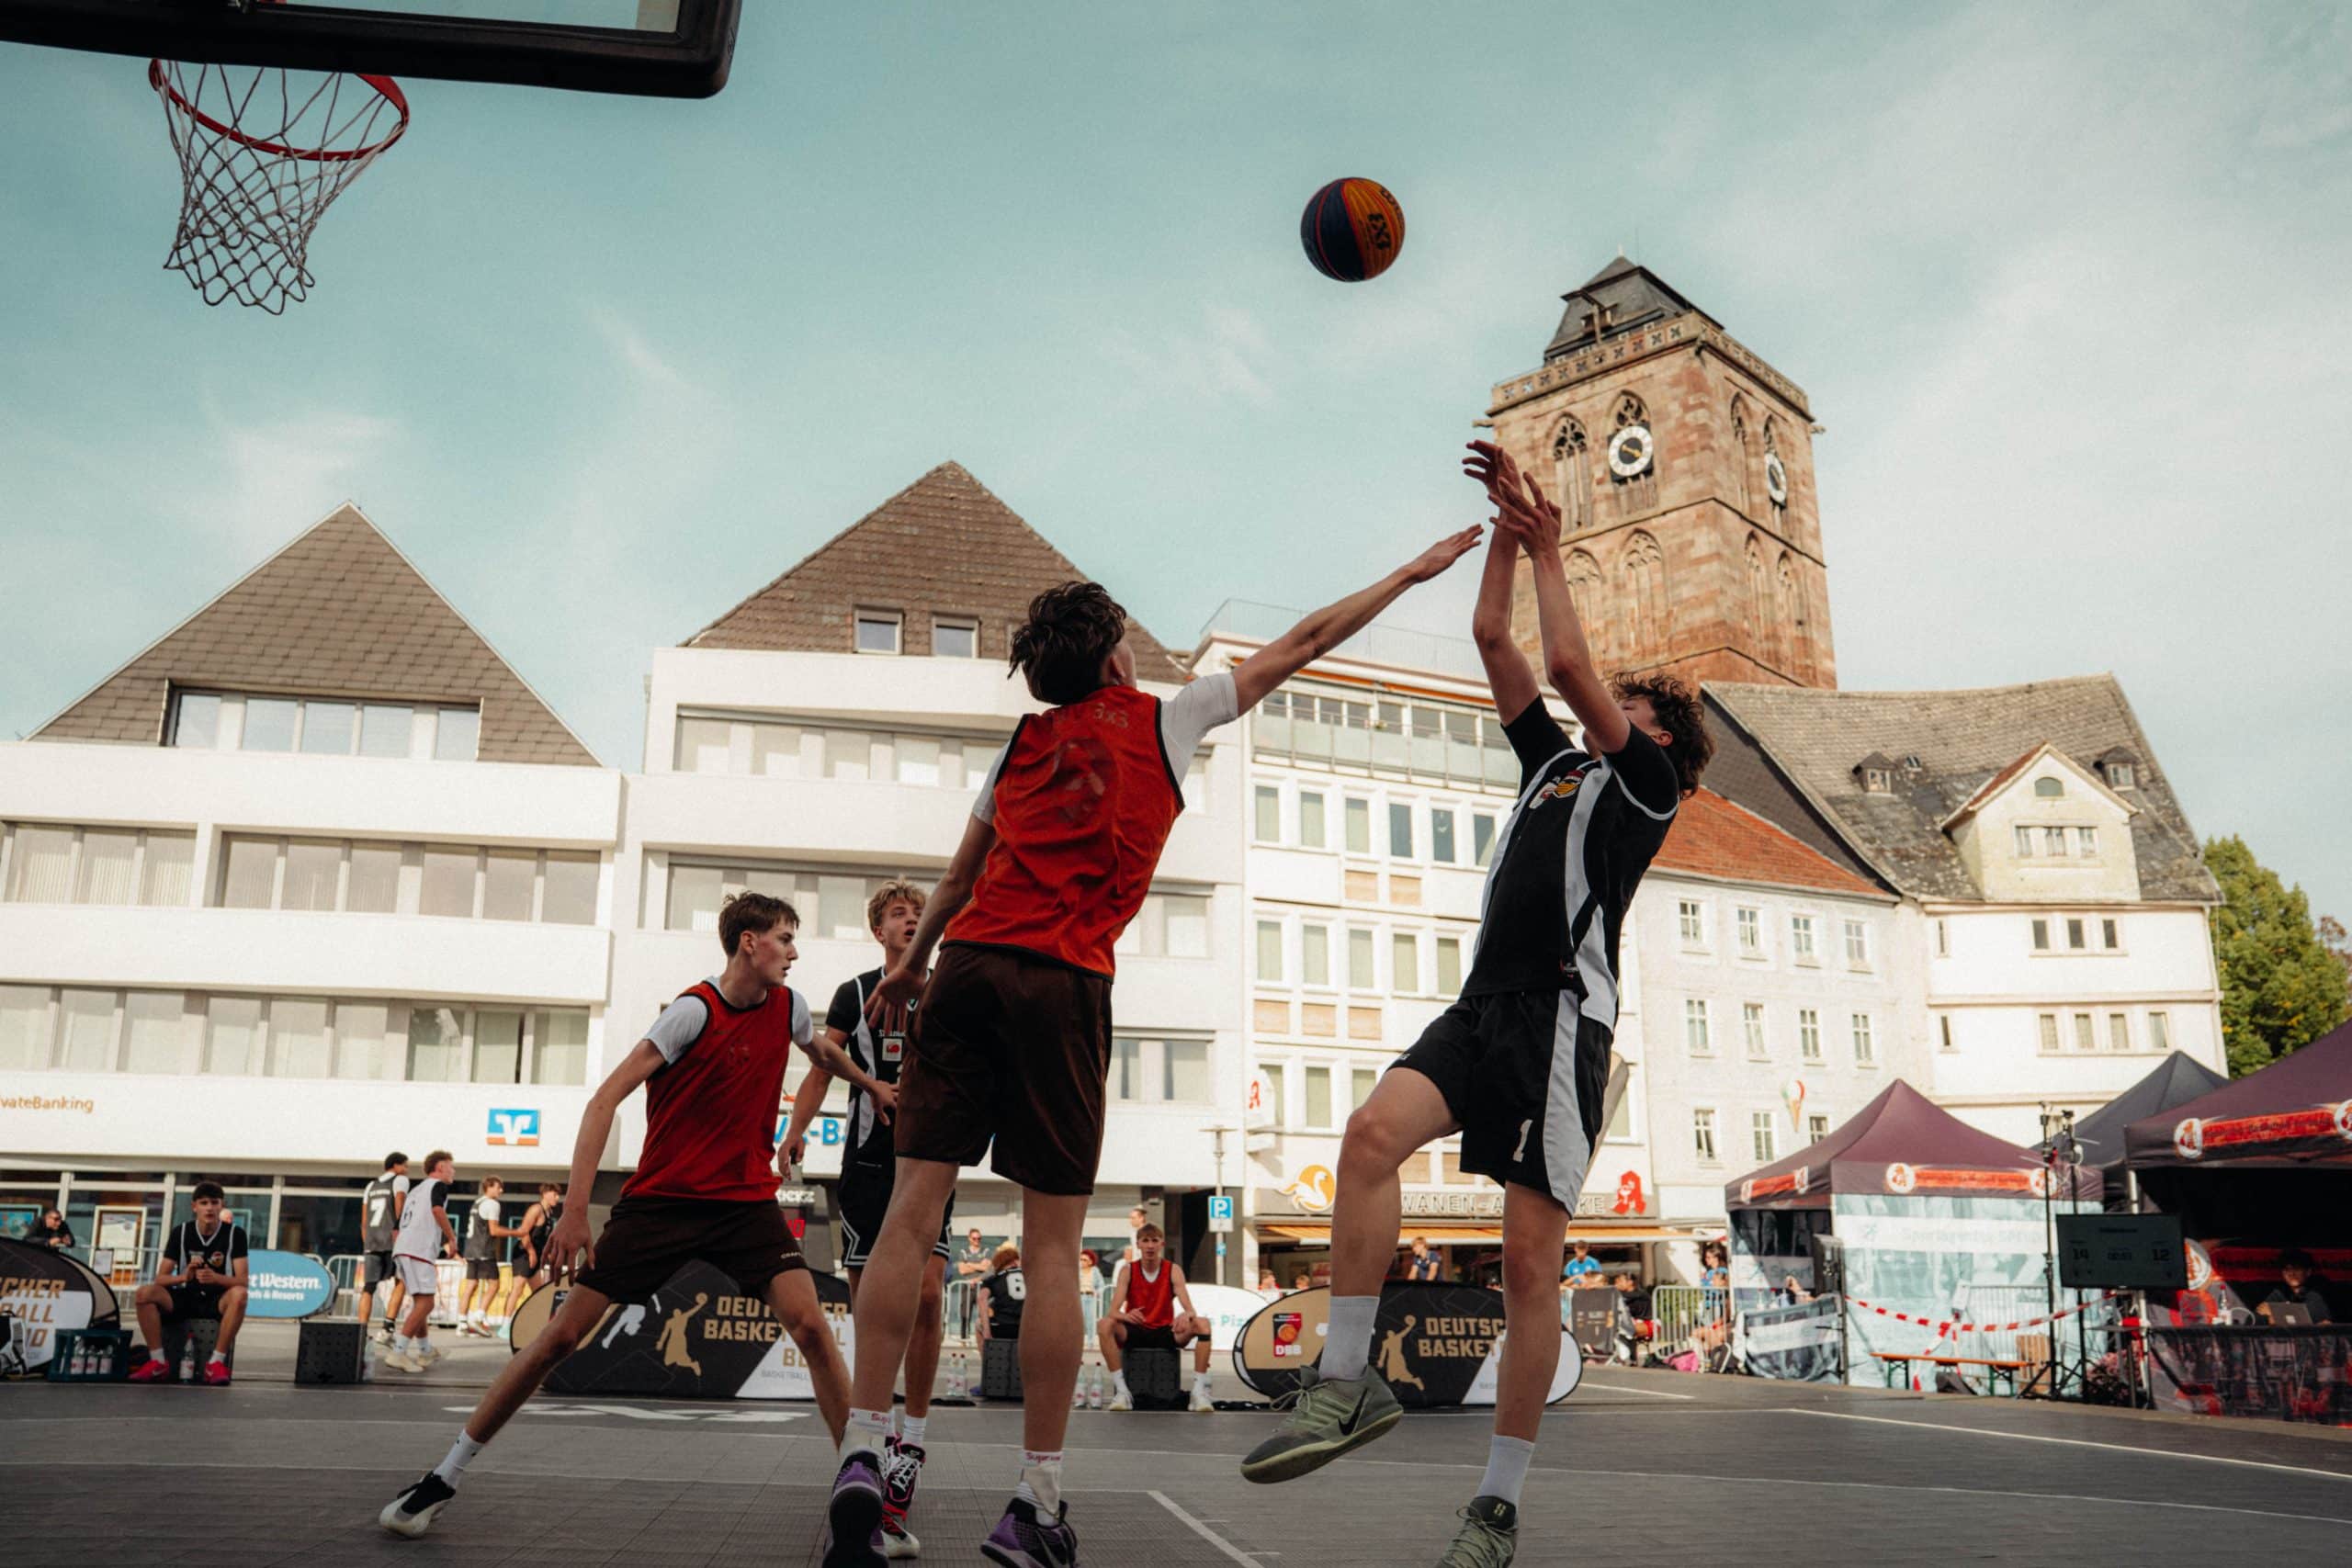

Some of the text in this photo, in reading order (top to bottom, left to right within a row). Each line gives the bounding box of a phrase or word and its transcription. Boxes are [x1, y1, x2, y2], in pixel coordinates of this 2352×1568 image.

[0, 1096, 94, 1113] vateBanking
[1513, 1119, 1532, 1163] 1
[369, 1198, 387, 1227] 7
[1214, 1200, 1228, 1218] P
[0, 1277, 66, 1299] CHER
[1006, 1272, 1026, 1300] 6
[1425, 1317, 1504, 1337] DEUTSC
[1418, 1338, 1498, 1358] BASKET
